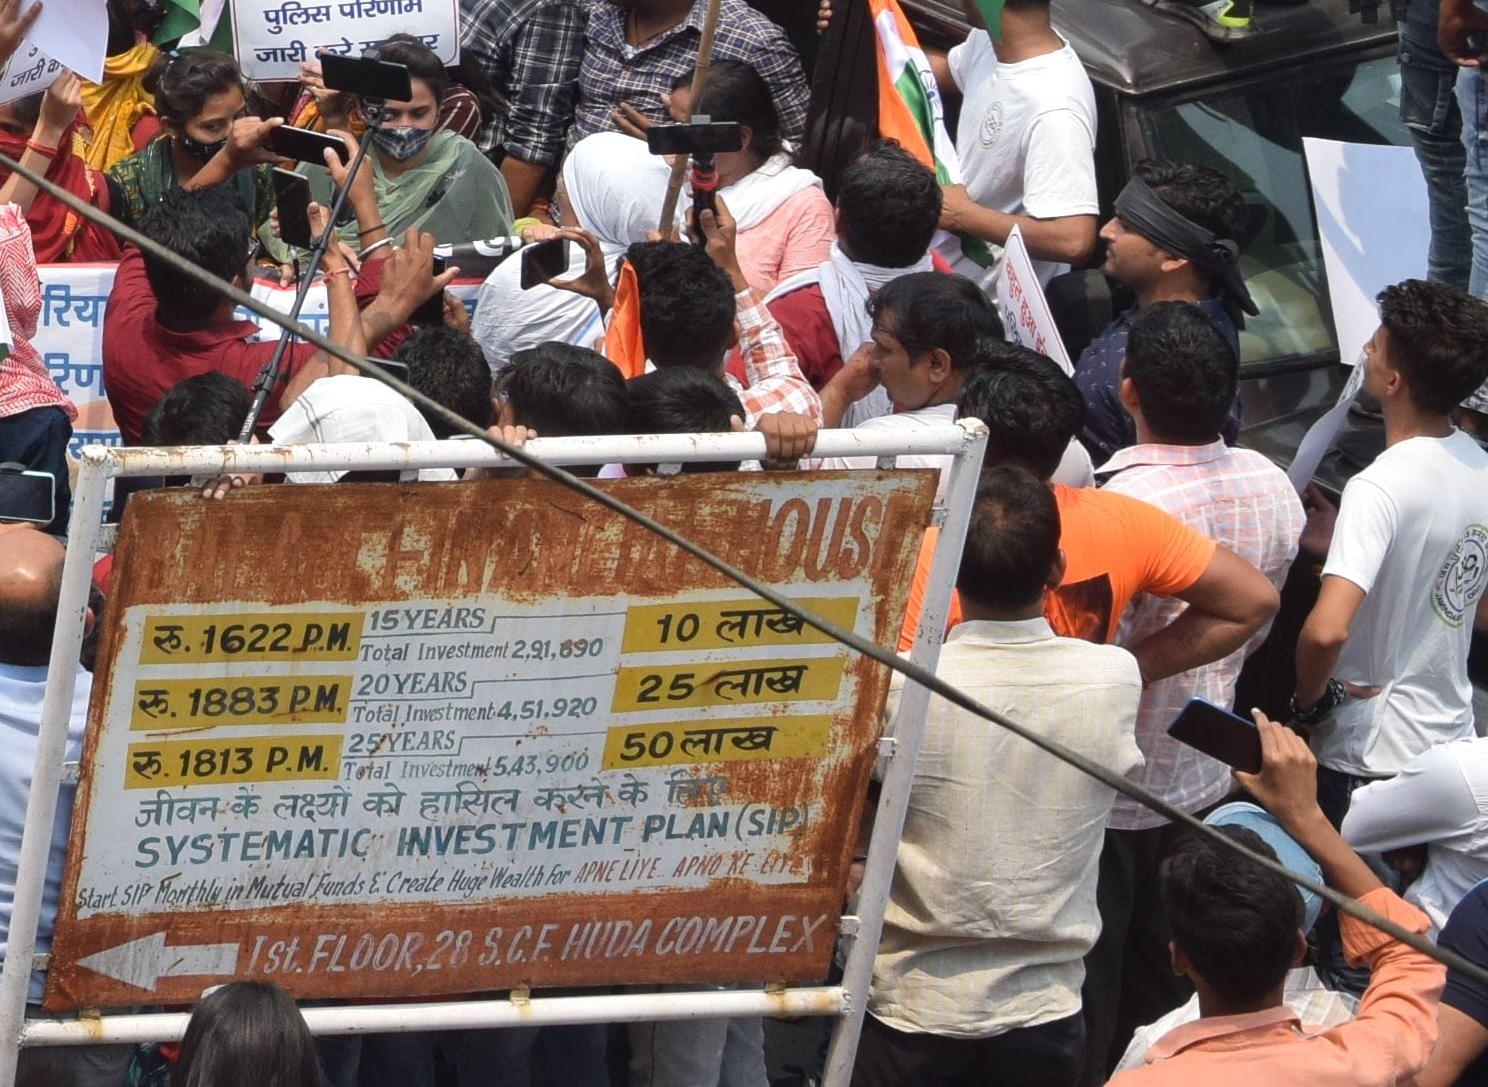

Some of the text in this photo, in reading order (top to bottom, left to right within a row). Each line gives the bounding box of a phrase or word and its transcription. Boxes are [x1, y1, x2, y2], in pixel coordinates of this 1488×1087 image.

[263, 1, 331, 34] पुलिस
[254, 40, 307, 62] जारी
[10, 57, 46, 87] जारी
[203, 623, 292, 654] 1622
[300, 622, 352, 652] P.M.
[656, 608, 805, 643] 10 लाख
[360, 642, 409, 661] Total
[418, 641, 509, 660] Investment
[637, 665, 808, 702] 25 लाख
[189, 686, 281, 717] 1883
[353, 704, 400, 723] Total
[405, 703, 494, 722] Investment
[619, 726, 779, 761] 50 लाख
[180, 748, 253, 777] 1813
[266, 745, 328, 773] P.M.
[343, 761, 390, 781] Total
[400, 760, 491, 779] Investment
[135, 789, 220, 828] जीवन
[230, 786, 262, 816] के
[362, 783, 407, 816] को
[420, 779, 521, 822] हासिल
[533, 775, 610, 813] करने
[618, 772, 650, 807] के
[135, 827, 372, 868] SYSTEMATIC
[397, 815, 634, 858] INVESTMENT
[642, 810, 730, 843] PLAN
[78, 887, 118, 910] Start
[122, 884, 152, 905] SIP
[157, 874, 220, 906] Monthly
[224, 880, 244, 899] in
[250, 875, 311, 899] Mutual
[314, 872, 364, 901] Funds
[387, 869, 444, 894] Create
[447, 869, 489, 899] Huge
[490, 865, 544, 890] Wealth
[574, 859, 614, 883] APNE
[672, 854, 720, 878] APNO
[561, 922, 646, 961] HUDA
[655, 914, 827, 956] COMPLEX
